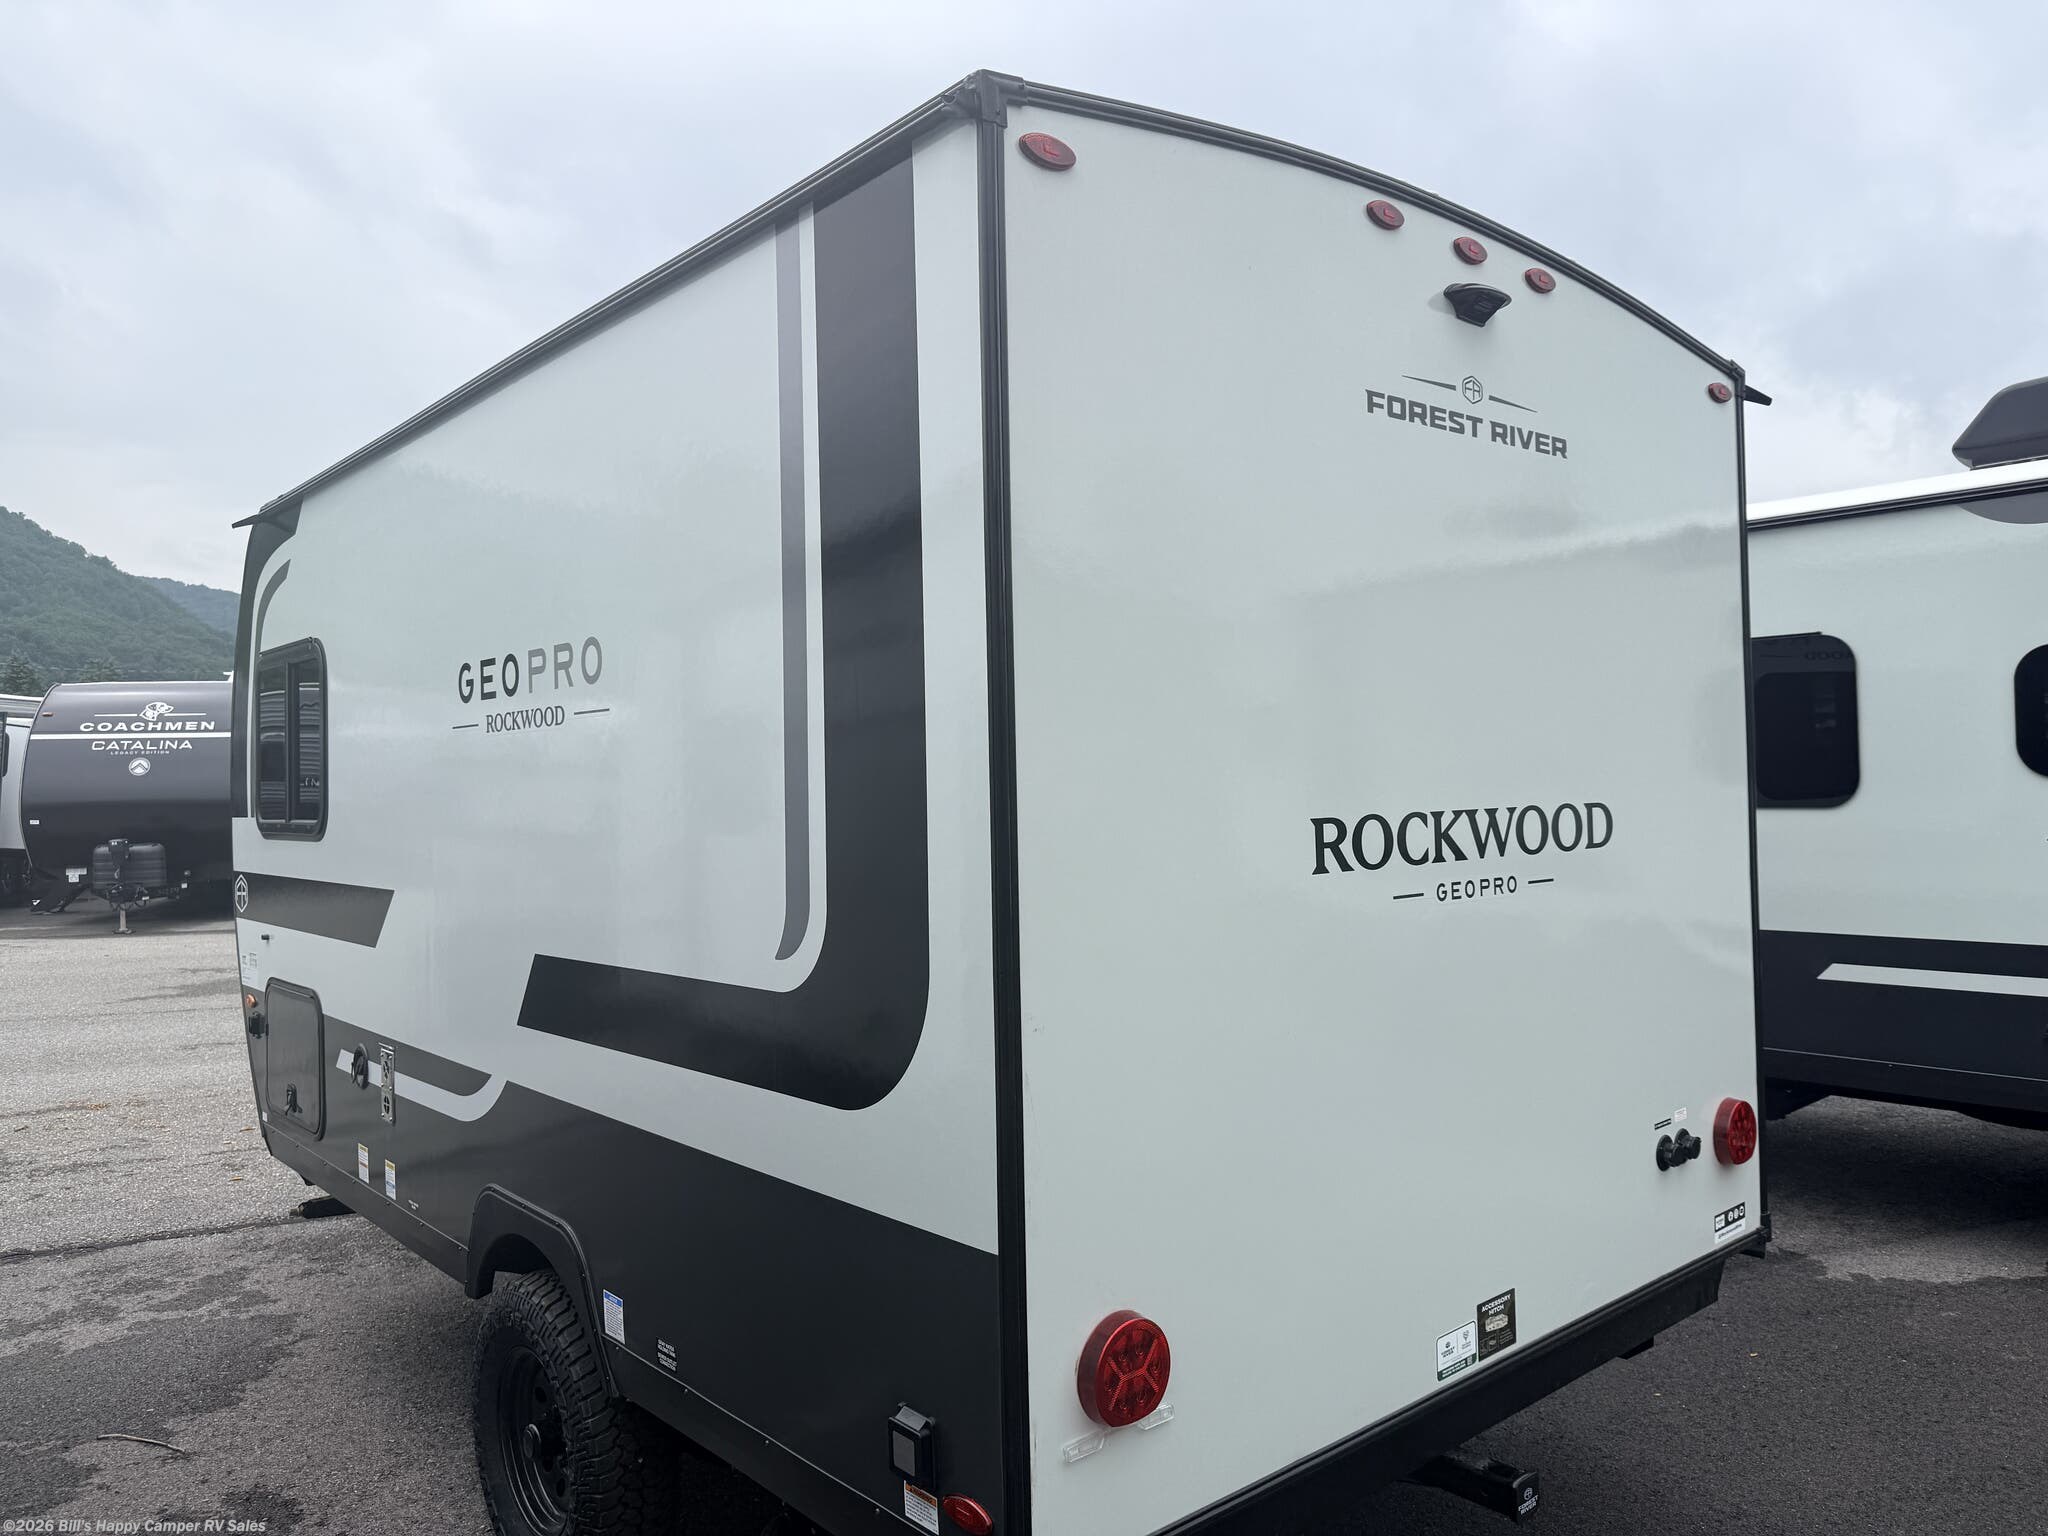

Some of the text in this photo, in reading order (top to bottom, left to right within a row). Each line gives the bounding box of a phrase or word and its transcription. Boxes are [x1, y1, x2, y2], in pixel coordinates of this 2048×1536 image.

[1365, 389, 1568, 459] FOREST RIVER
[458, 636, 603, 704] GEOPRO
[79, 721, 215, 732] COACHMEN
[486, 705, 566, 733] ROCKWOOD
[91, 740, 193, 751] CATALINA
[1310, 802, 1614, 875] ROCKWOOD
[1436, 875, 1518, 902] GEOPRO
[1481, 1293, 1511, 1313] ACCESSORY
[1518, 1494, 1539, 1512] FOREST
[1520, 1501, 1537, 1515] RIVER
